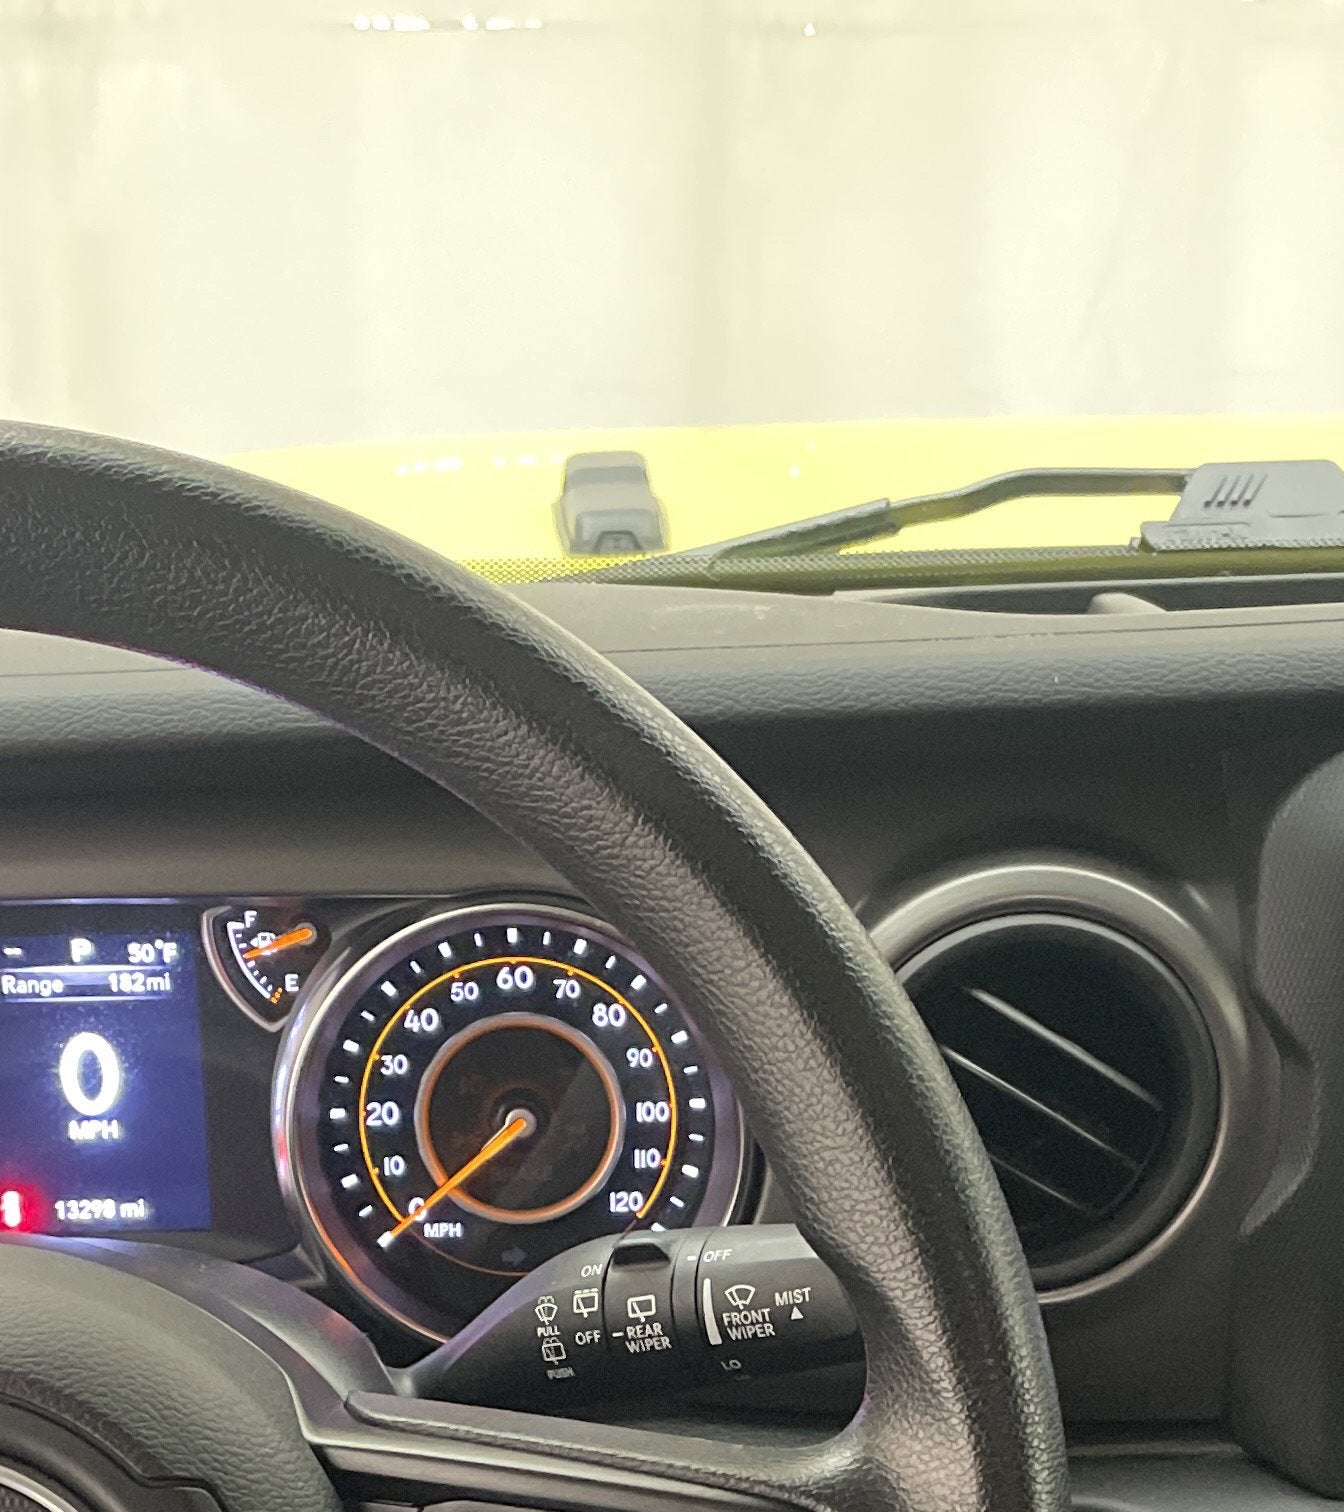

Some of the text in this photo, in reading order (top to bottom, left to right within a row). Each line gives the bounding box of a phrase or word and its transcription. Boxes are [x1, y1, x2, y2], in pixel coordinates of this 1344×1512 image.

[244, 910, 257, 928] F
[70, 937, 93, 963] P
[1, 974, 64, 996] Range
[285, 973, 300, 992] E
[496, 964, 535, 992] 60
[552, 977, 581, 1000] 70
[450, 980, 479, 1002] 50
[404, 1007, 439, 1033] 40
[591, 1002, 627, 1028] 80
[380, 1053, 410, 1076] 30
[625, 1047, 654, 1069] 90
[58, 1031, 122, 1117] 0
[366, 1101, 399, 1127] 20
[634, 1100, 670, 1124] 100
[68, 1120, 120, 1141] MPH
[382, 1155, 406, 1178] 10
[633, 1147, 663, 1169] 110
[119, 1198, 145, 1218] mi
[609, 1191, 644, 1214] 120
[423, 1222, 462, 1238] MPH
[702, 1249, 732, 1263] OFF
[581, 1263, 603, 1278] ON
[774, 1286, 812, 1307] MIST
[722, 1308, 771, 1327] FRONT
[537, 1325, 561, 1338] PULL
[575, 1329, 601, 1346] OFF
[626, 1322, 664, 1339] REAR
[726, 1323, 776, 1342] WIPER
[625, 1336, 673, 1354] WIPER
